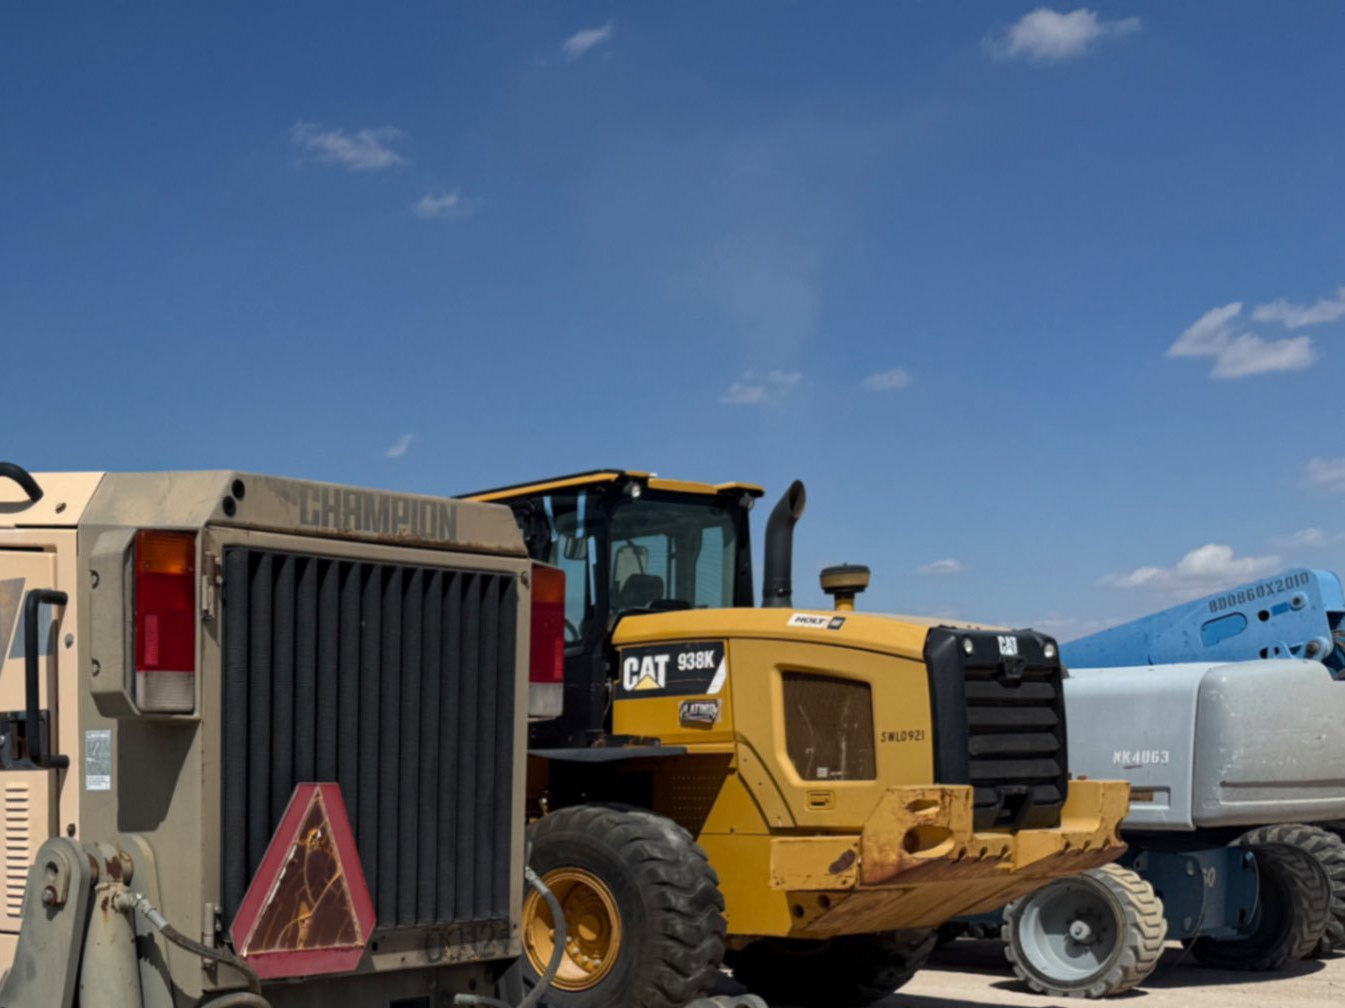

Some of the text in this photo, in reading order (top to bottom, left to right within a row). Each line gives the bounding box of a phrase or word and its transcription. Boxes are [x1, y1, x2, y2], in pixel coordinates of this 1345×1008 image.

[300, 484, 458, 543] CHAMPION
[623, 650, 716, 691] CAT 938K
